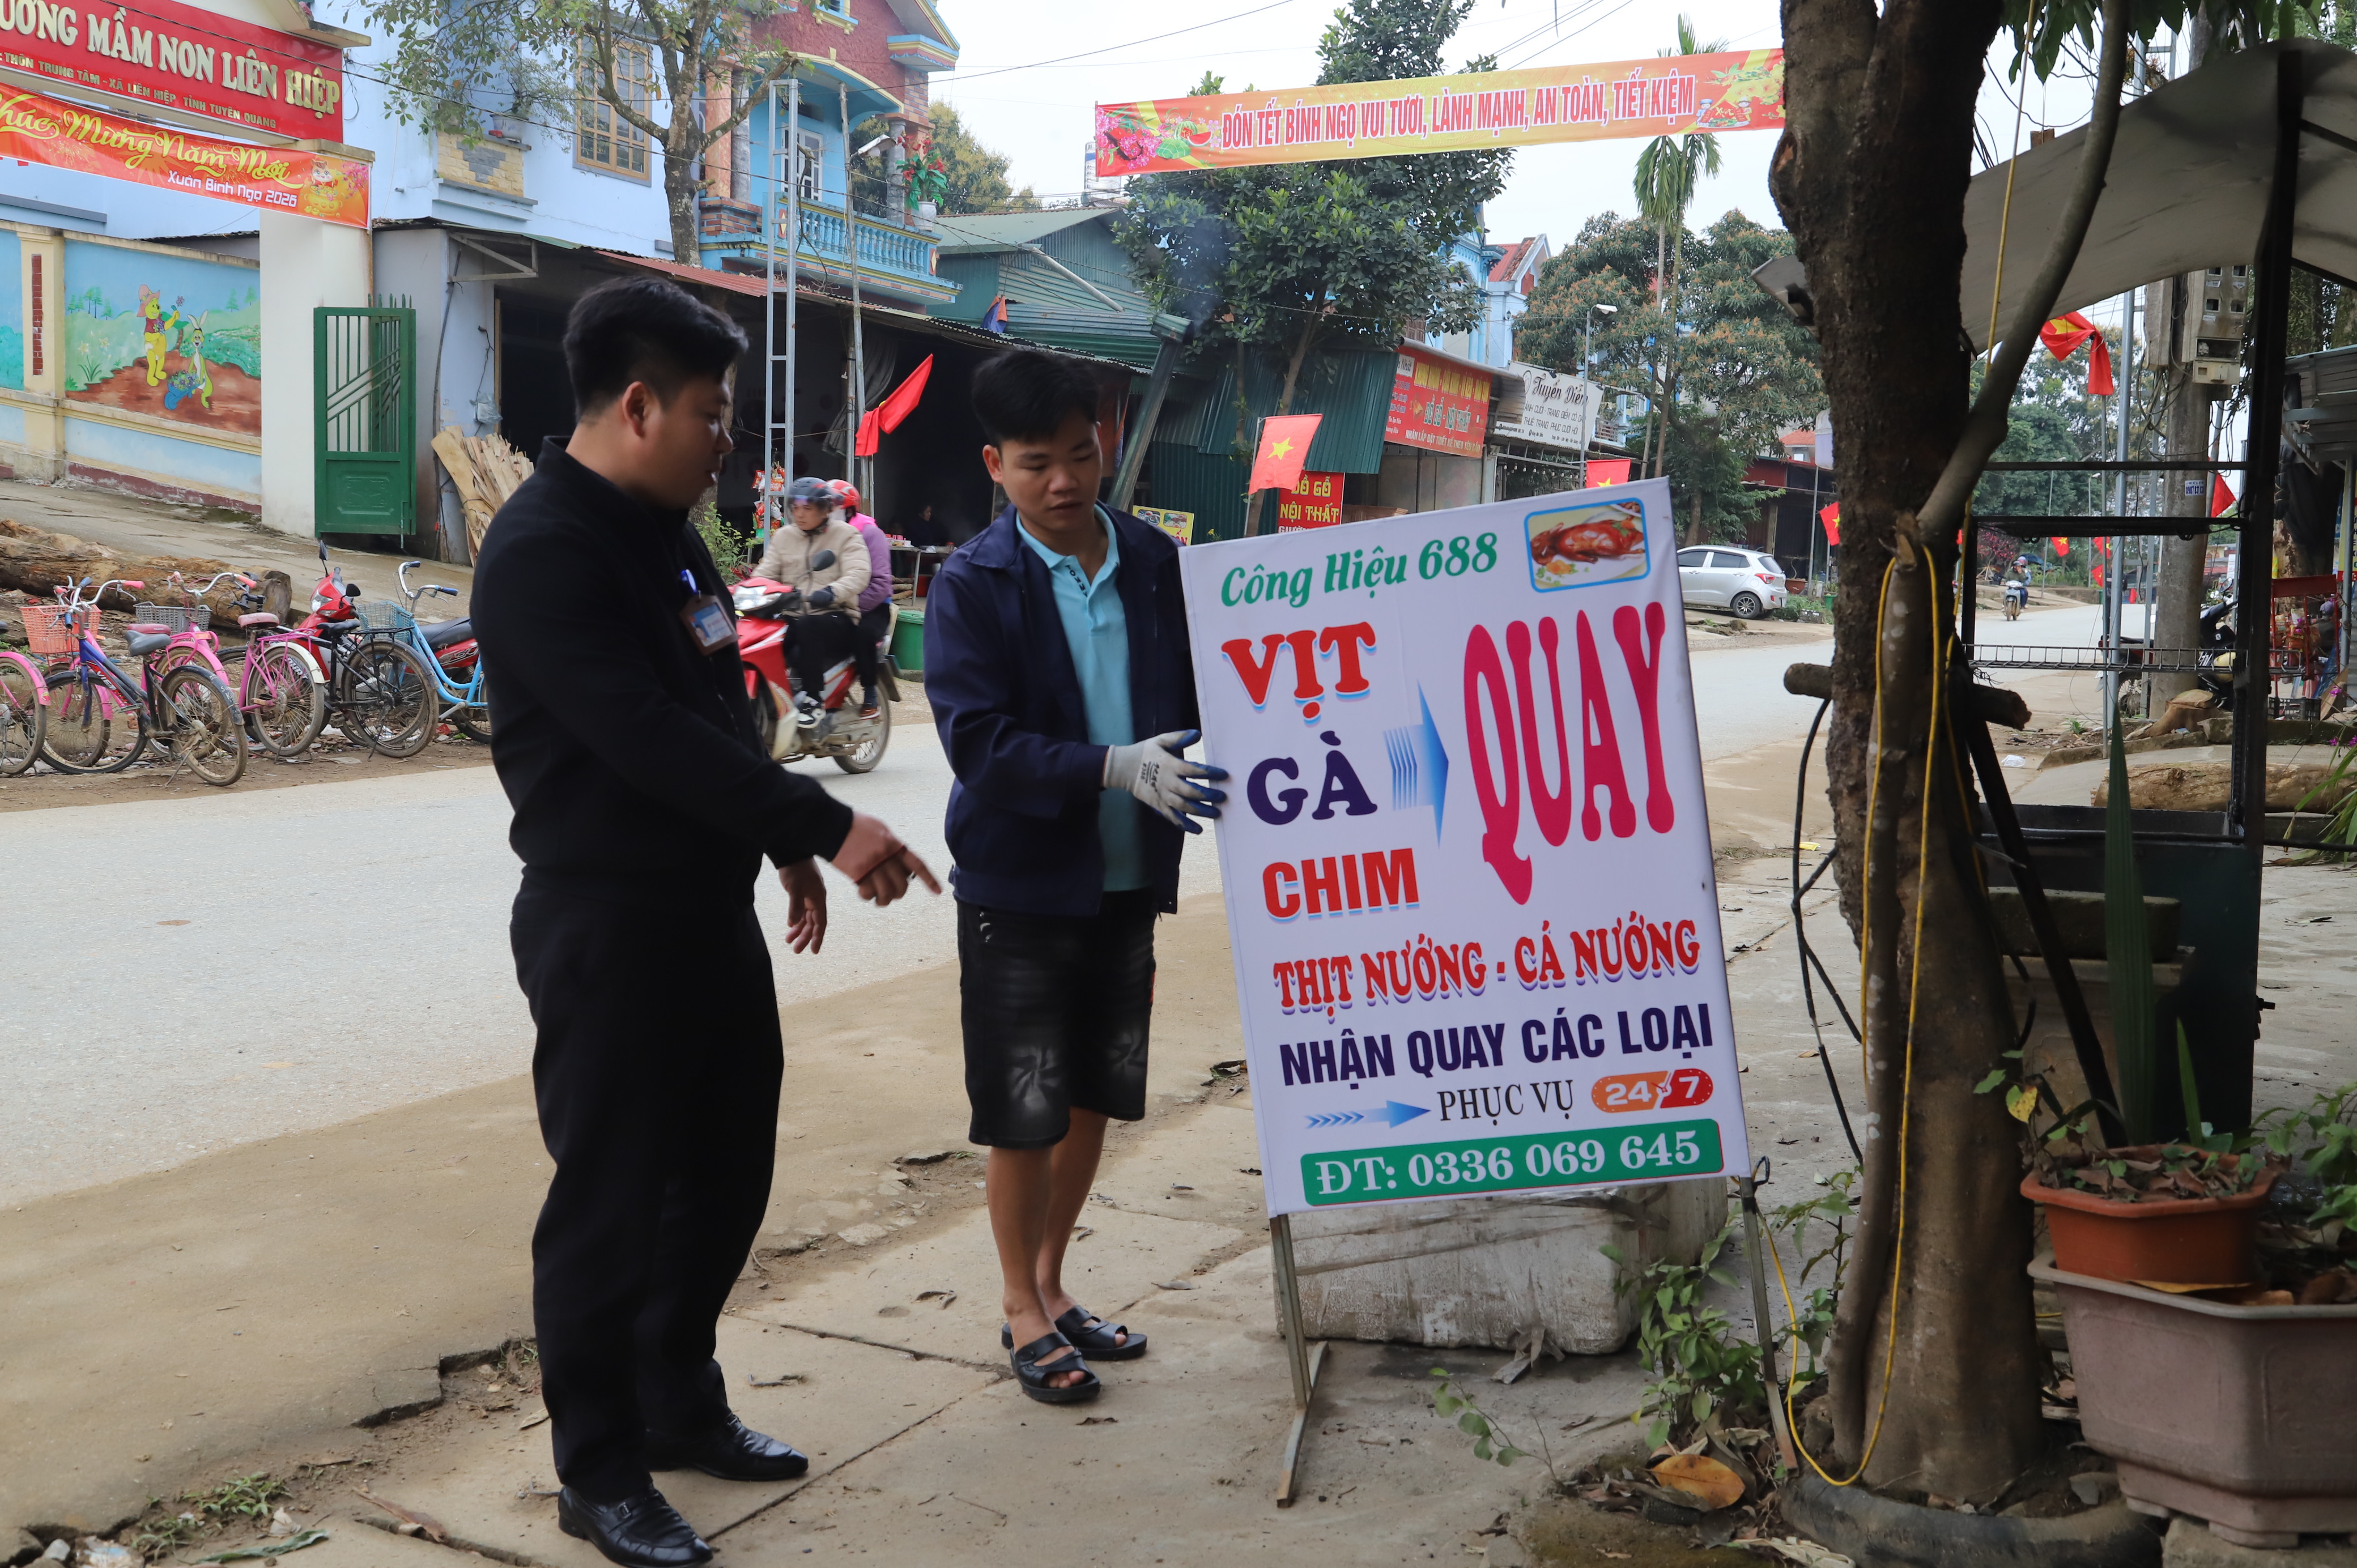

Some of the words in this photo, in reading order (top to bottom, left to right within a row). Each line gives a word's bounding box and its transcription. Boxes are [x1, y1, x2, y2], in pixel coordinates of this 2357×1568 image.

[4, 52, 34, 69] THÔN
[38, 60, 74, 79] TRUNG
[77, 69, 100, 85] TÂM
[109, 78, 124, 91] XÃ
[127, 83, 150, 97] LIÊN
[154, 89, 177, 104] HIỆP
[183, 95, 206, 111] TỈNH
[210, 104, 241, 120] TUYÊN
[244, 112, 276, 129] QUANG
[86, 6, 153, 67] MẦM
[157, 33, 215, 83] NON
[220, 48, 278, 100] LIÊN
[284, 67, 340, 119] HIỆP
[1221, 104, 1253, 150] ĐÓN
[1257, 97, 1283, 147] TẾT
[1284, 99, 1321, 146] BÍNH
[1324, 101, 1356, 148] NGỌ
[1360, 100, 1386, 139] VUI
[1389, 93, 1428, 139] TƯƠI,
[1431, 87, 1474, 134] LÀNH
[1475, 88, 1530, 138] MẠNH,
[1531, 86, 1558, 126] AN
[1560, 75, 1609, 126] TOÀN,
[1613, 67, 1648, 121] TIẾT
[1649, 68, 1695, 125] KIỆM
[63, 110, 153, 169] Mừng
[123, 127, 227, 177] Năm
[212, 145, 304, 189] Mới
[167, 170, 202, 189] Xuân
[205, 178, 233, 195] Bính
[237, 185, 262, 202] Ngọ
[265, 190, 297, 207] 2026
[1405, 429, 1418, 441] NHẬN
[1427, 434, 1436, 445] ĐẶT
[1436, 435, 1447, 446] THIẾT
[1454, 440, 1463, 449] THEO
[1547, 407, 1559, 418] TRANG
[1280, 501, 1301, 523] NỘI
[1305, 502, 1339, 523] THẤT
[1313, 476, 1331, 497] GỖ
[1220, 564, 1312, 608] Công
[1323, 547, 1407, 600] Hiệu
[1419, 532, 1498, 581] 688
[1221, 621, 1377, 726] VỊT
[1246, 730, 1378, 826] GÀ
[1463, 601, 1674, 905] QUAY
[1261, 847, 1420, 923] CHIM
[1273, 955, 1353, 1024] THỊT
[1360, 932, 1486, 1006] NƯỚNG
[1514, 919, 1567, 990] CÁ
[1569, 910, 1701, 986] NƯỚNG
[1279, 1031, 1395, 1090] NHẬN
[1407, 1022, 1506, 1079] QUAY
[1522, 1007, 1605, 1064] CÁC
[1619, 1002, 1713, 1059] LOẠI
[1436, 1083, 1524, 1126] PHỤC
[1530, 1079, 1575, 1120] VỤ
[1314, 1156, 1398, 1195] ĐT:
[1407, 1147, 1514, 1187] 0336
[1525, 1139, 1605, 1177] 069
[1619, 1129, 1700, 1166] 645
